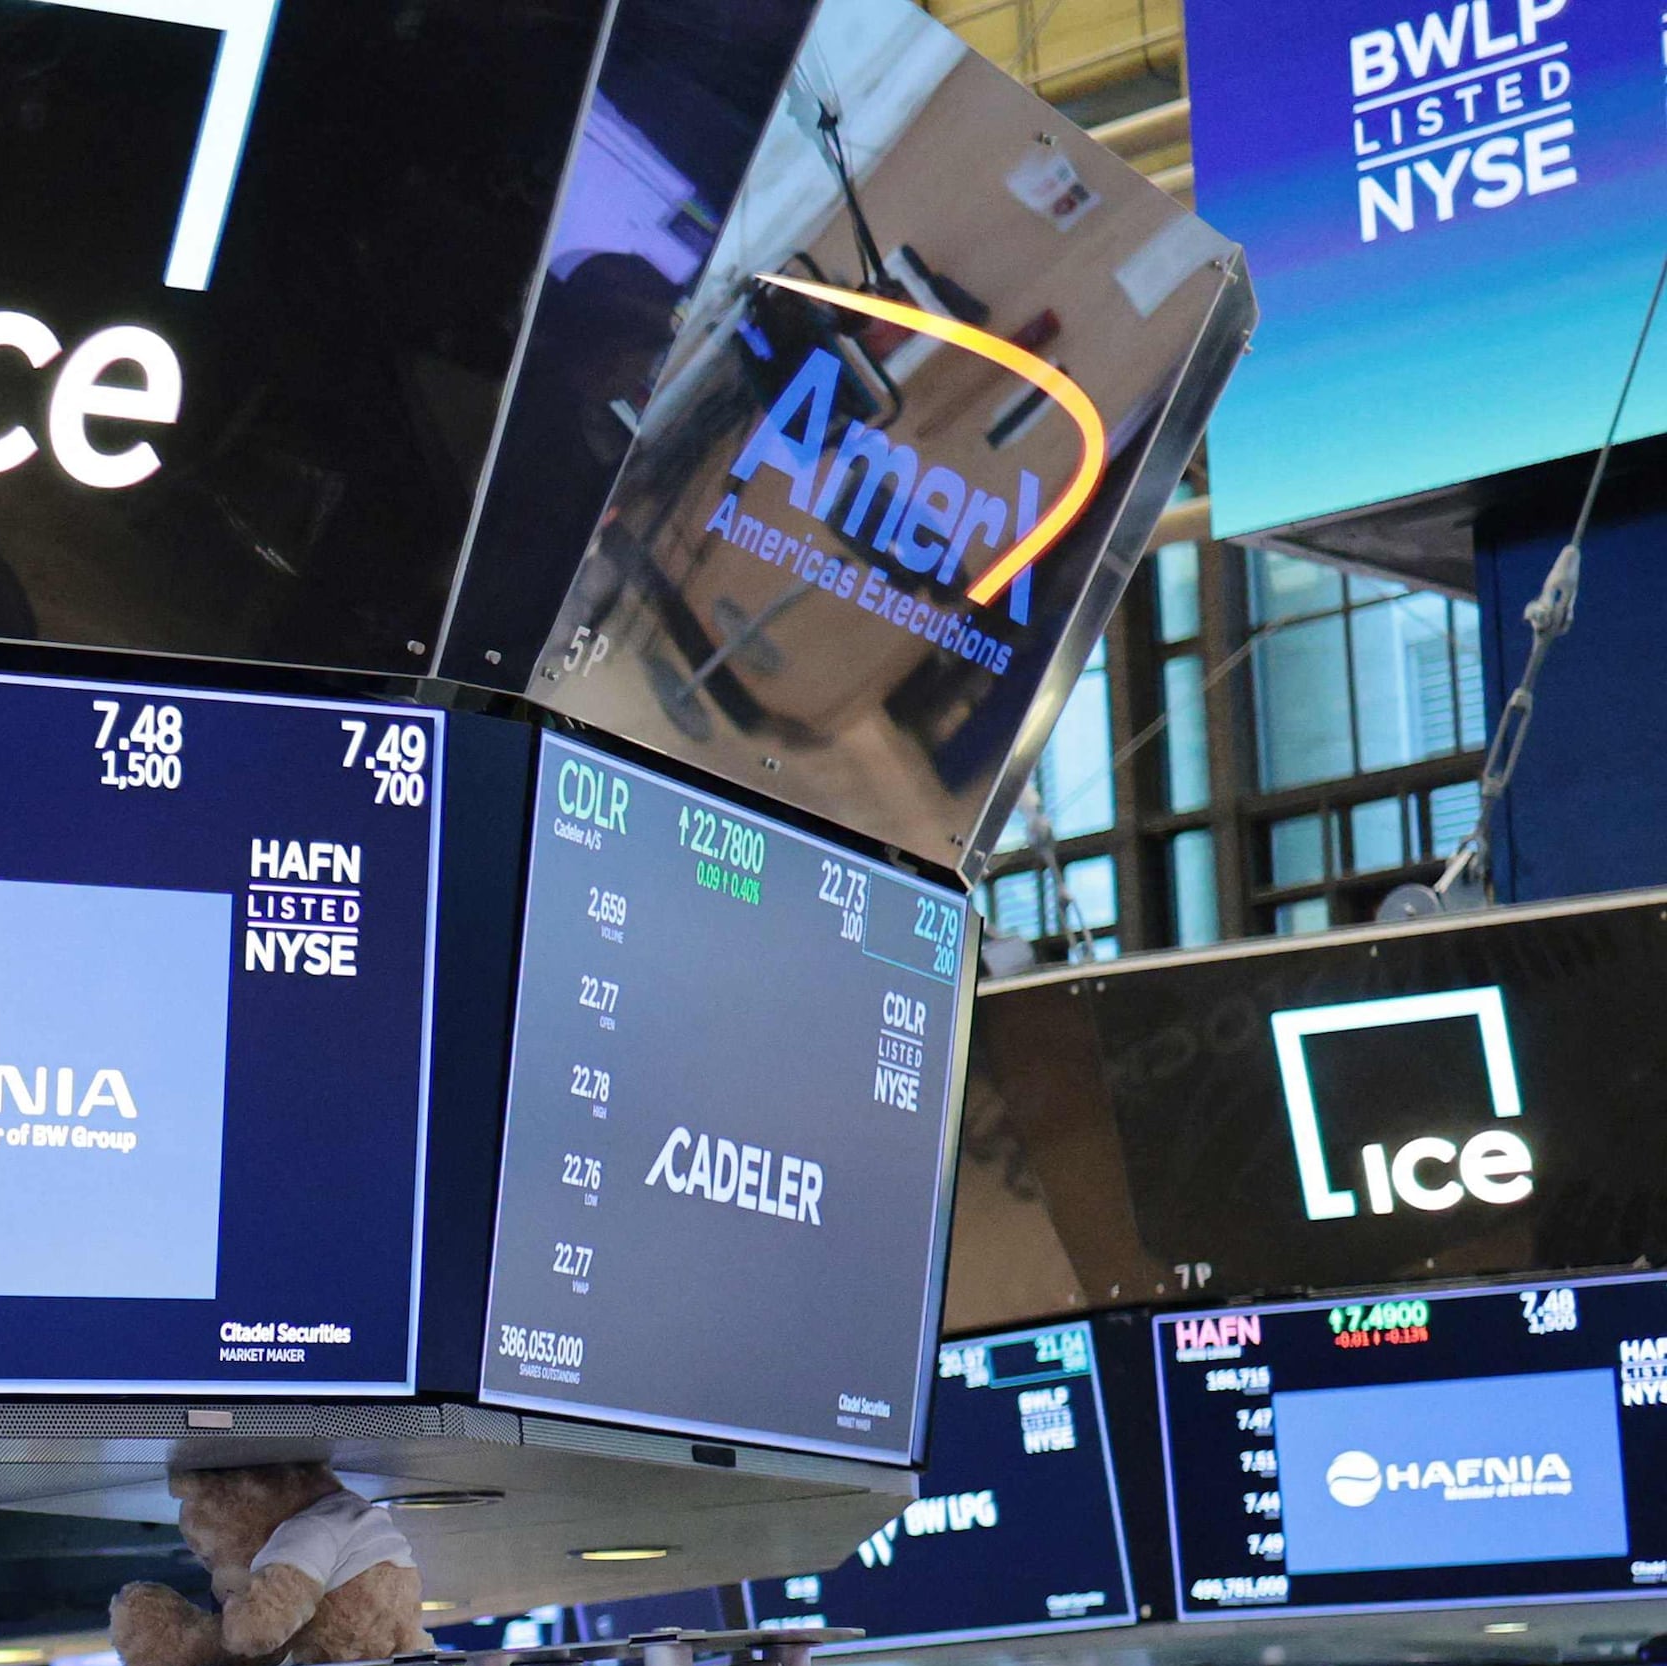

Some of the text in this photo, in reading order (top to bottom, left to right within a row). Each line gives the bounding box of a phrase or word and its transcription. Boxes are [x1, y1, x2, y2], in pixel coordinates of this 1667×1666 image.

[1350, 0, 1567, 98] BWLP
[1353, 61, 1571, 156] LISTED
[1359, 118, 1577, 242] NYSE
[705, 493, 1013, 675] Americas Executions
[93, 701, 183, 755] 7.48
[341, 721, 425, 773] 7.49
[101, 752, 181, 790] 1,500
[373, 771, 424, 807] 700
[557, 759, 630, 835] CDLR
[554, 818, 602, 851] Cadeler A/S
[690, 808, 765, 874] 22.7800
[250, 839, 360, 884] HAFN
[697, 865, 760, 905] 0.09 0.40%
[819, 860, 866, 914] 22.73
[247, 894, 359, 923] LISTED
[588, 886, 626, 928] 2,659
[914, 897, 958, 948] 22.79
[841, 912, 863, 944] 100
[245, 930, 357, 976] NYSE
[934, 944, 954, 977] 200
[579, 975, 619, 1014] 22.77
[882, 991, 926, 1037] CDLR
[878, 1035, 922, 1070] LISTED
[571, 1064, 610, 1102] 22.78
[873, 1071, 919, 1113] NYSE
[7, 1122, 29, 1147] of
[31, 1124, 69, 1150] BW
[72, 1126, 136, 1153] Group
[562, 1153, 601, 1190] 22.76
[645, 1126, 823, 1225] CADELER
[553, 1242, 593, 1278] 22.77
[1520, 1288, 1575, 1317] 7.48
[219, 1322, 351, 1346] Citadel Securities
[499, 1325, 583, 1368] 386,053,000
[1176, 1316, 1261, 1350] HAFN
[219, 1347, 305, 1364] MARKET MAKER
[1386, 1453, 1571, 1491] HAFNIA
[949, 1490, 997, 1531] LPG
